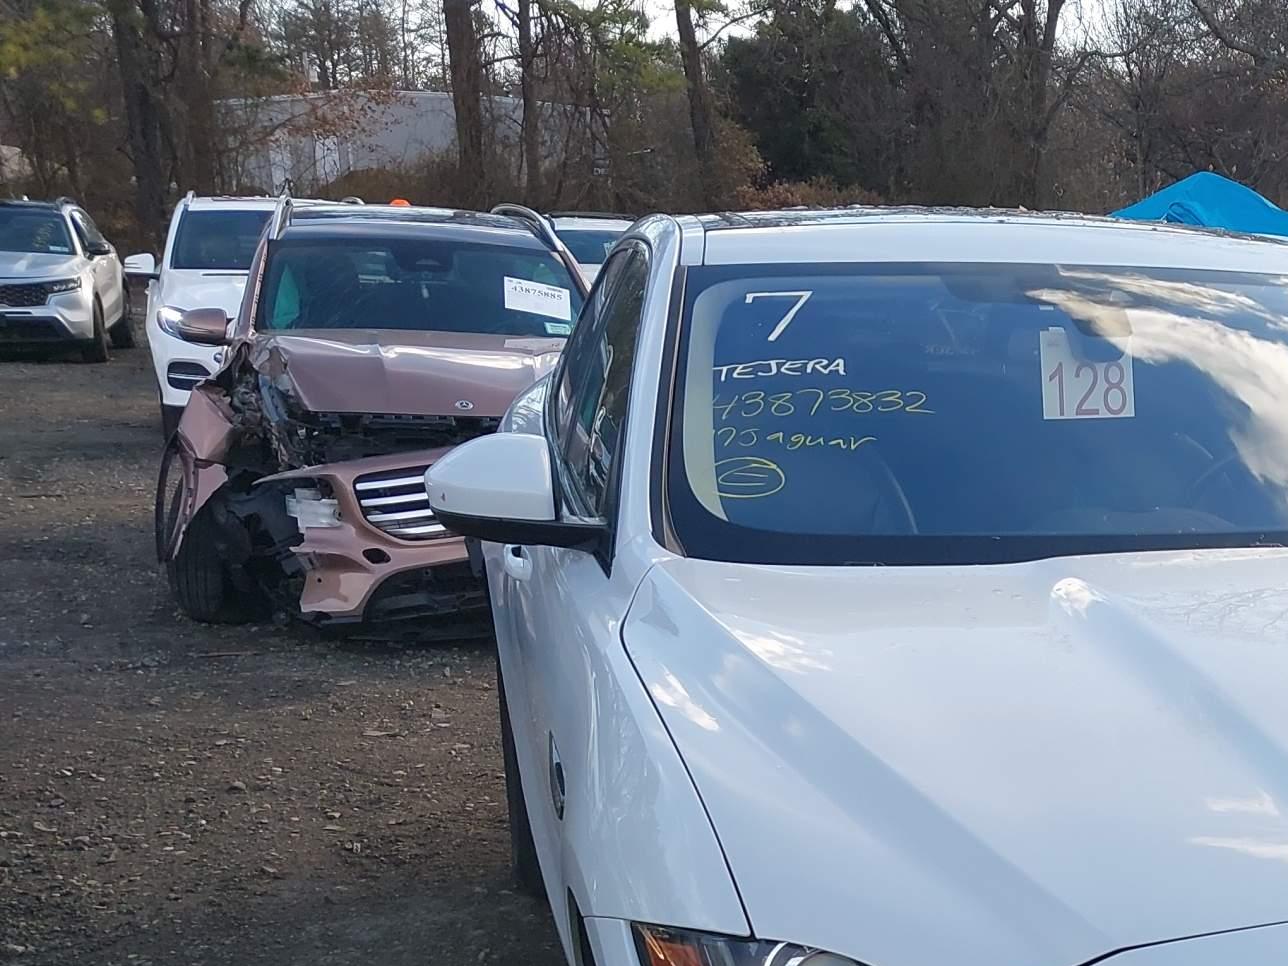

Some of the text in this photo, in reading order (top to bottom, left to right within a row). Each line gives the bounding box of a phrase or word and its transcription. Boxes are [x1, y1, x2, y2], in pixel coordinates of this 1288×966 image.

[745, 291, 813, 341] 7
[712, 358, 847, 382] TEJERA
[1048, 361, 1127, 417] 128
[712, 388, 936, 420] 43873832
